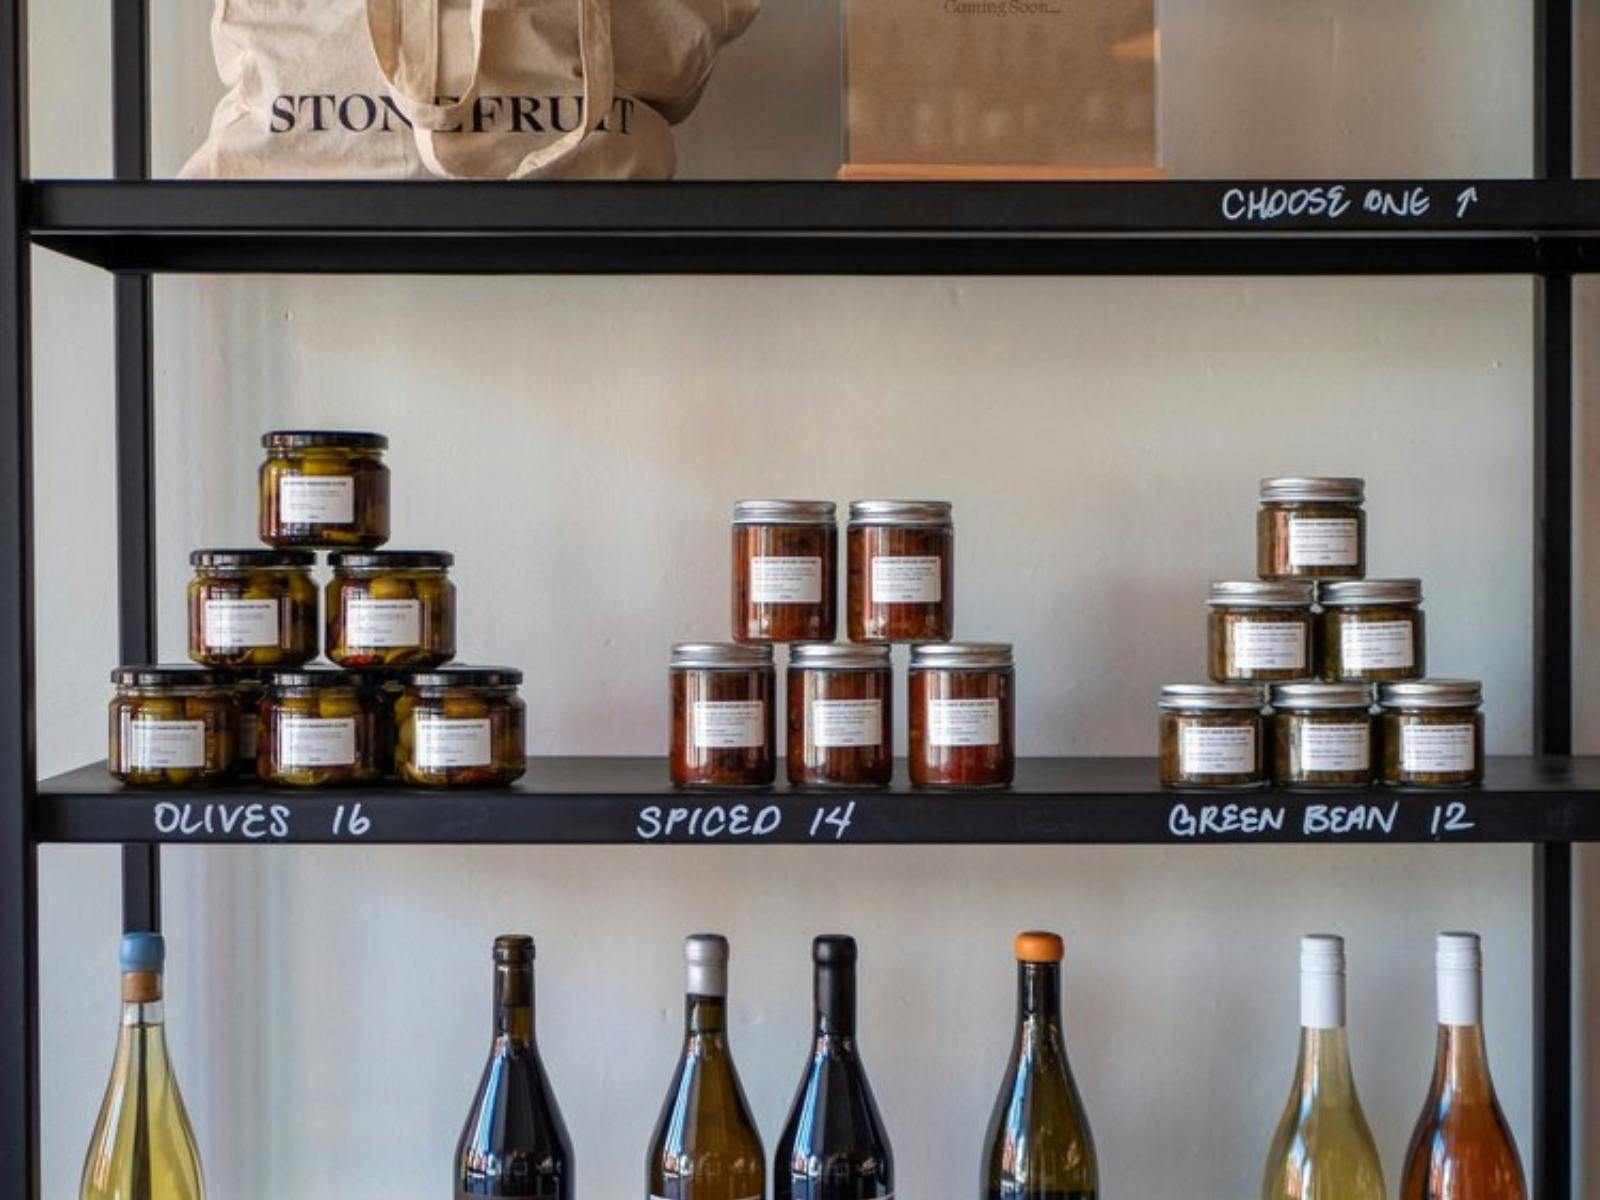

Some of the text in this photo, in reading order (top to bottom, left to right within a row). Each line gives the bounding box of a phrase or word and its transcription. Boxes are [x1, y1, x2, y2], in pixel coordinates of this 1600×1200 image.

[943, 0, 1007, 17] Coming
[270, 92, 634, 134] STONFRUT
[1222, 185, 1429, 220] CHOOSE ONE
[154, 802, 371, 838] OLIVES 16
[637, 801, 855, 839] SPICED 14
[1169, 802, 1474, 836] GREEN BEAN 12
